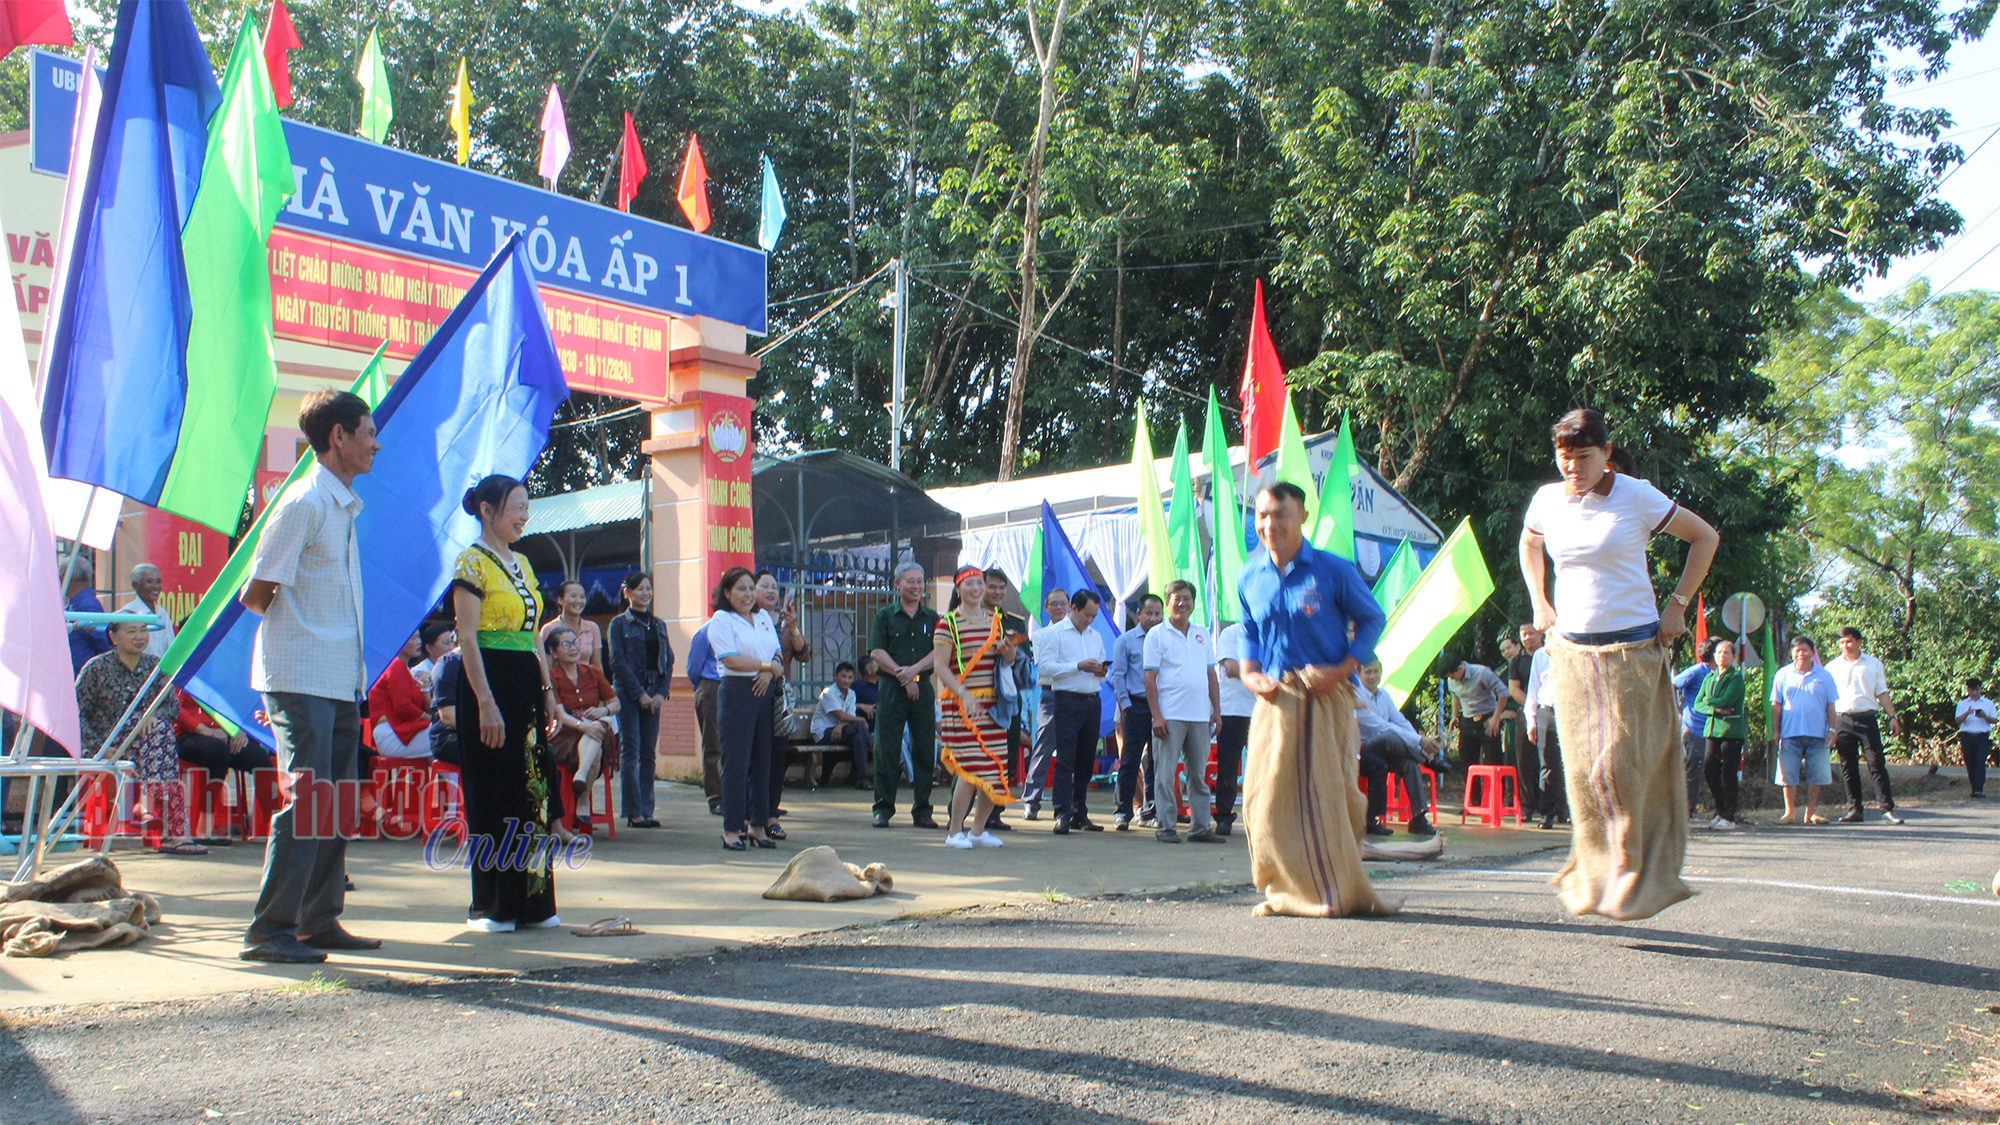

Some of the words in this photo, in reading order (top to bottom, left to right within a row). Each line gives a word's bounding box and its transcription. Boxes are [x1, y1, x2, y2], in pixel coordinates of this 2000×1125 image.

[366, 182, 474, 254] VĂN
[601, 229, 659, 296] ẤP
[674, 265, 692, 306] 1
[272, 246, 296, 283] LIỆT
[298, 253, 328, 285] CHÀO
[330, 259, 363, 293] MỪNG
[365, 269, 378, 295] 94
[380, 269, 405, 301] NĂM
[406, 276, 434, 306] NGÀY
[555, 305, 572, 338] TỘC
[573, 307, 601, 340] THỐNG
[602, 314, 624, 345] NHẤT
[625, 321, 642, 352] VIỆT
[643, 327, 662, 352] NAM
[276, 292, 306, 325] NGÀY
[353, 304, 387, 339] THỐNG
[389, 313, 412, 348] MẶT
[584, 353, 634, 385] 18/11/2024).
[707, 473, 728, 507] THÀNH
[730, 475, 751, 508] CÔNG
[178, 531, 202, 574] ĐẠI
[708, 519, 728, 552] THÀNH
[729, 521, 752, 554] CÔNG
